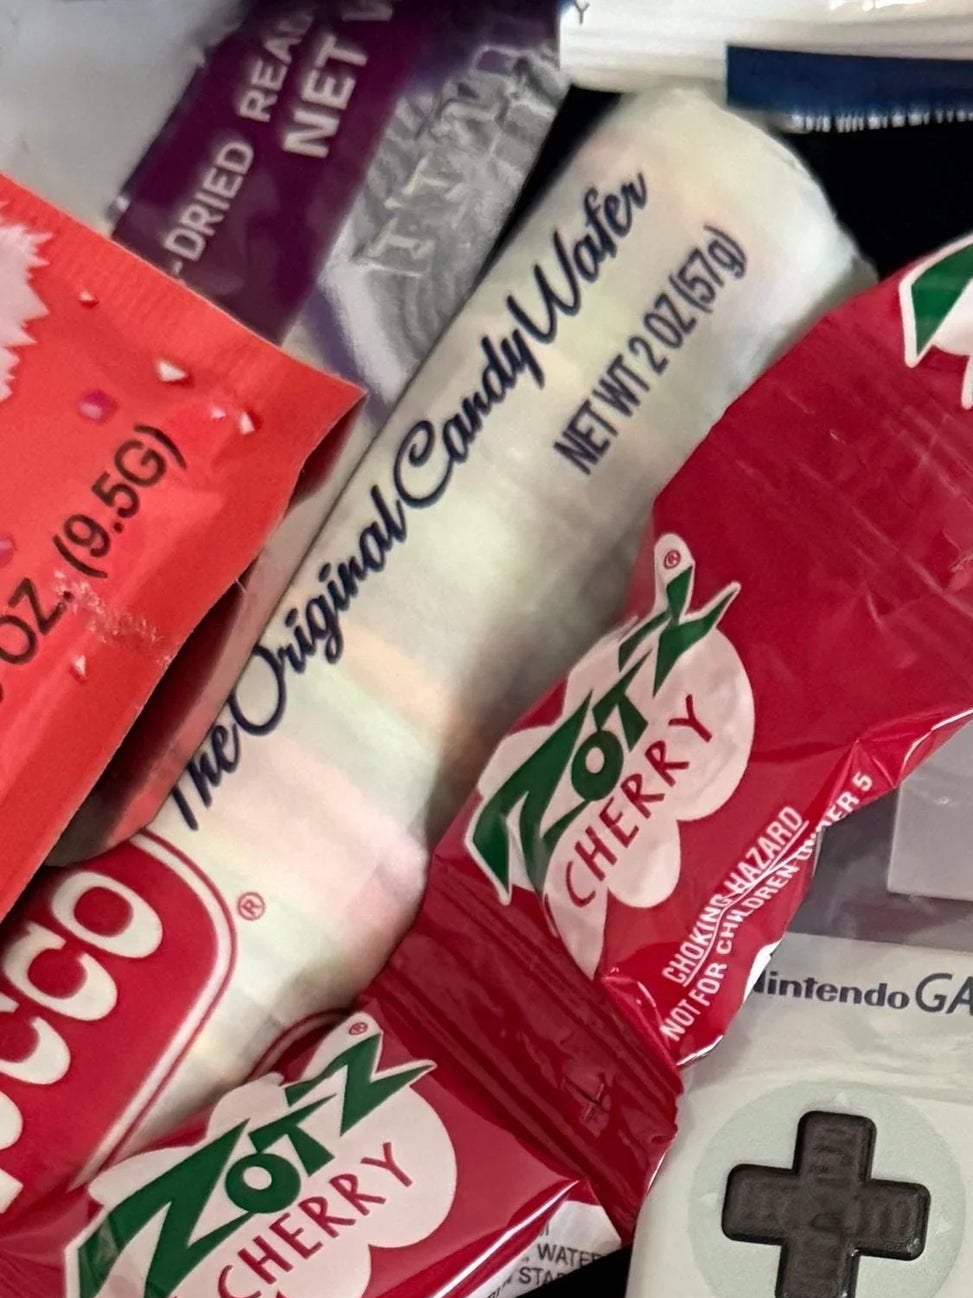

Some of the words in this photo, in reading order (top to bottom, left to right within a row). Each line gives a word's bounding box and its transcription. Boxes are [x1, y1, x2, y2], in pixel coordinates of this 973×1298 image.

[282, 32, 368, 158] NET
[592, 354, 651, 418] WT
[628, 336, 669, 375] 2
[643, 293, 697, 349] OZ
[227, 484, 409, 736] Original
[393, 324, 545, 509] Candy
[508, 171, 648, 345] Wafer
[553, 399, 619, 475] NET
[0, 577, 75, 665] OZ.
[53, 424, 188, 579] (9.5G)
[472, 566, 738, 900] ZOTZ
[565, 694, 713, 908] CHERRY
[659, 998, 702, 1041] NOT
[689, 962, 728, 1007] FOR
[716, 863, 800, 955] CHILDREN
[852, 771, 873, 792] 5
[661, 892, 734, 986] CHOKING
[722, 805, 804, 896] HAZARD
[0, 870, 164, 1185] CCO
